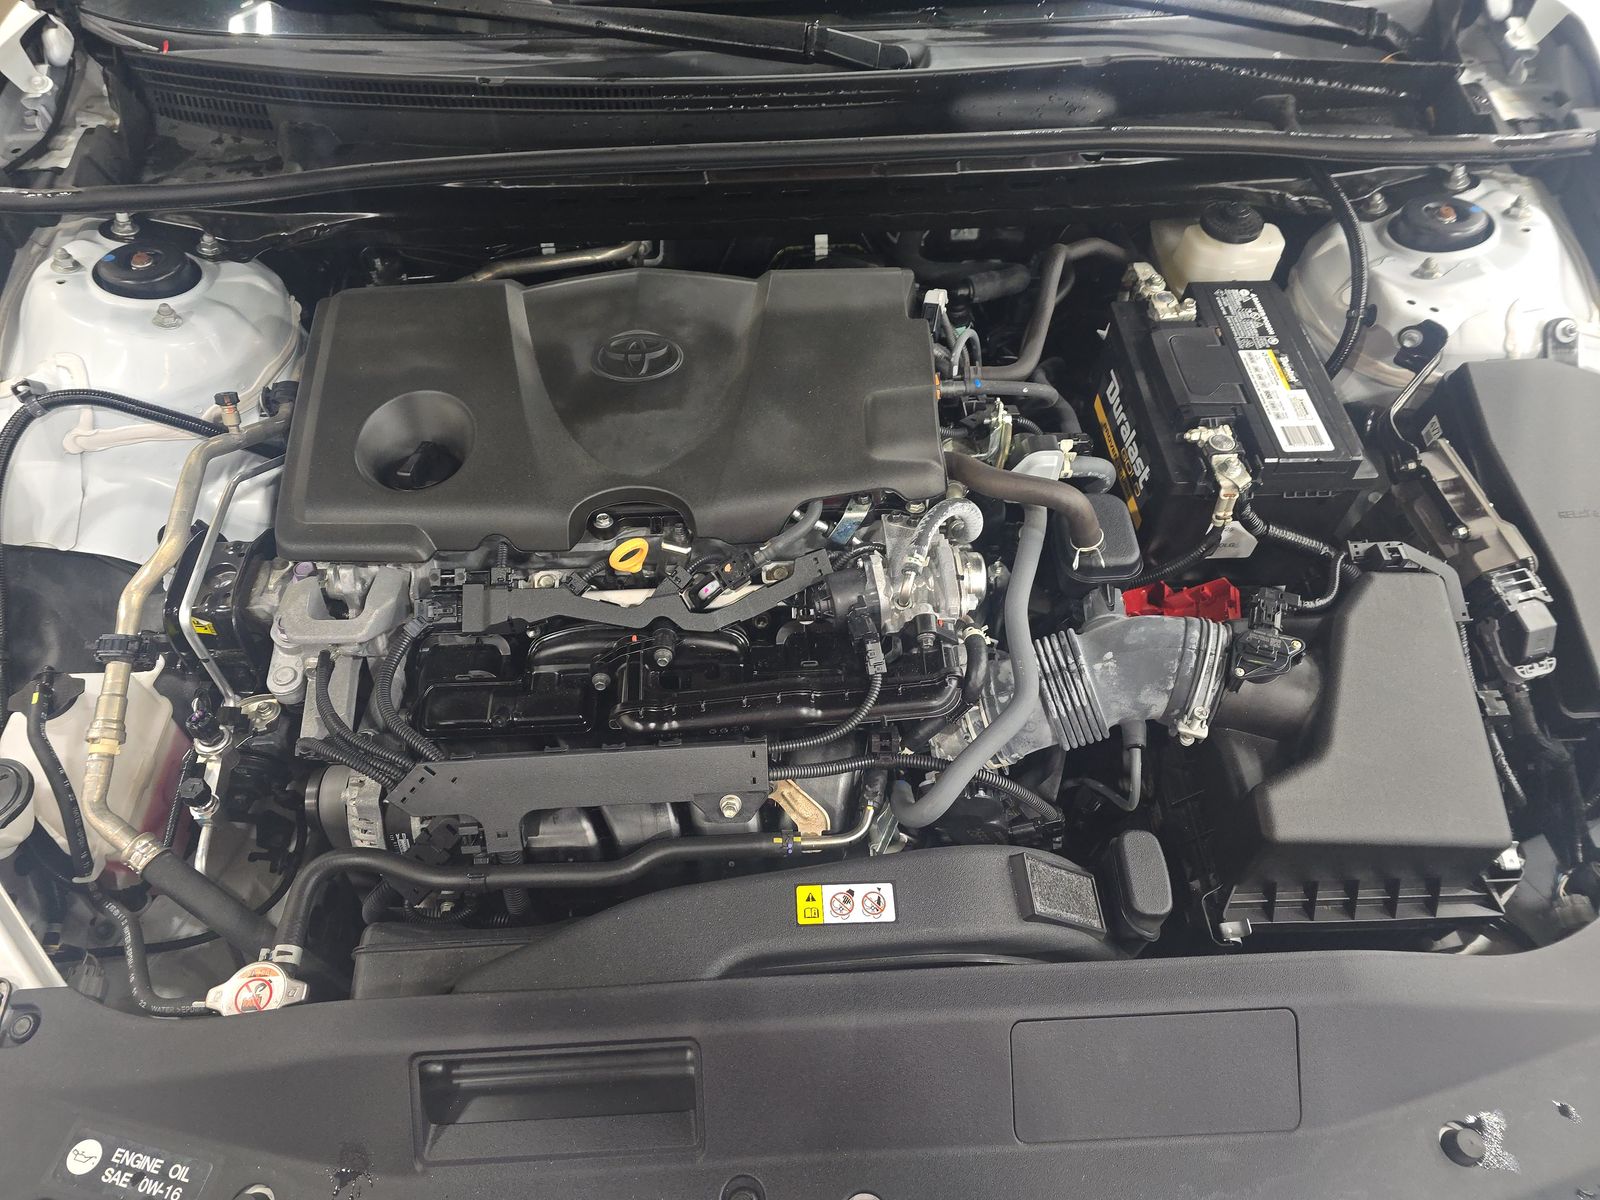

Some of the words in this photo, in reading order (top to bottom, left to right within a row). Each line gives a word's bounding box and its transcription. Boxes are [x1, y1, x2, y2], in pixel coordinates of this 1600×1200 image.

[1105, 368, 1150, 489] Duralast
[138, 999, 148, 1009] 22
[150, 1004, 175, 1014] WATER
[111, 1147, 164, 1175] ENGINE
[168, 1163, 190, 1183] OIL
[101, 1167, 133, 1188] SAE
[137, 1177, 183, 1200] 0W-16
